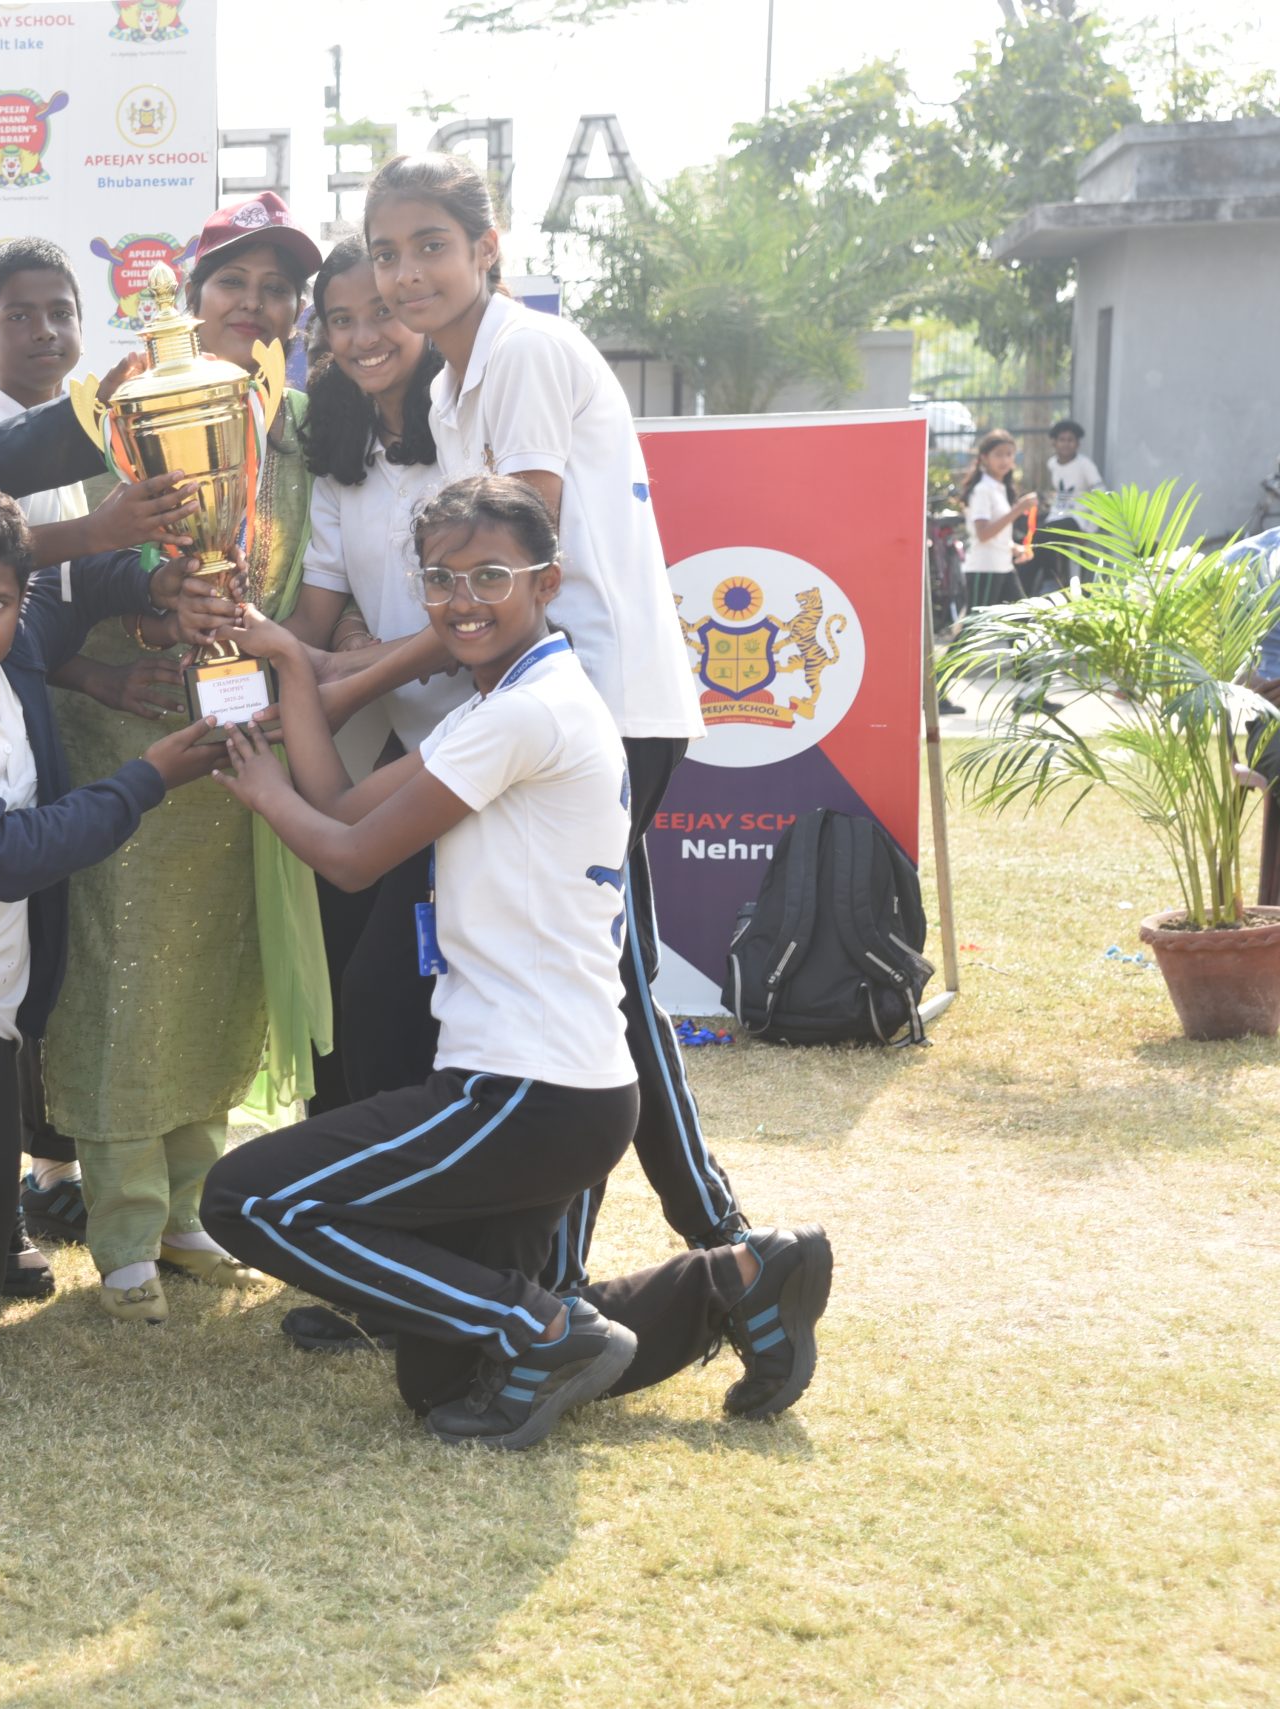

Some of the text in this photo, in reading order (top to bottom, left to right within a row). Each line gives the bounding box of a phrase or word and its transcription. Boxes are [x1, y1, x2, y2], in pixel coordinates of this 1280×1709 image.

[15, 14, 75, 28] SCHOOL
[14, 38, 44, 50] lake
[84, 152, 209, 168] APEEJAY SCHOOL
[97, 175, 195, 189] Bhubaneswar
[701, 703, 781, 717] PEEJAY SCHOOL
[654, 812, 798, 833] EEJAY SCH
